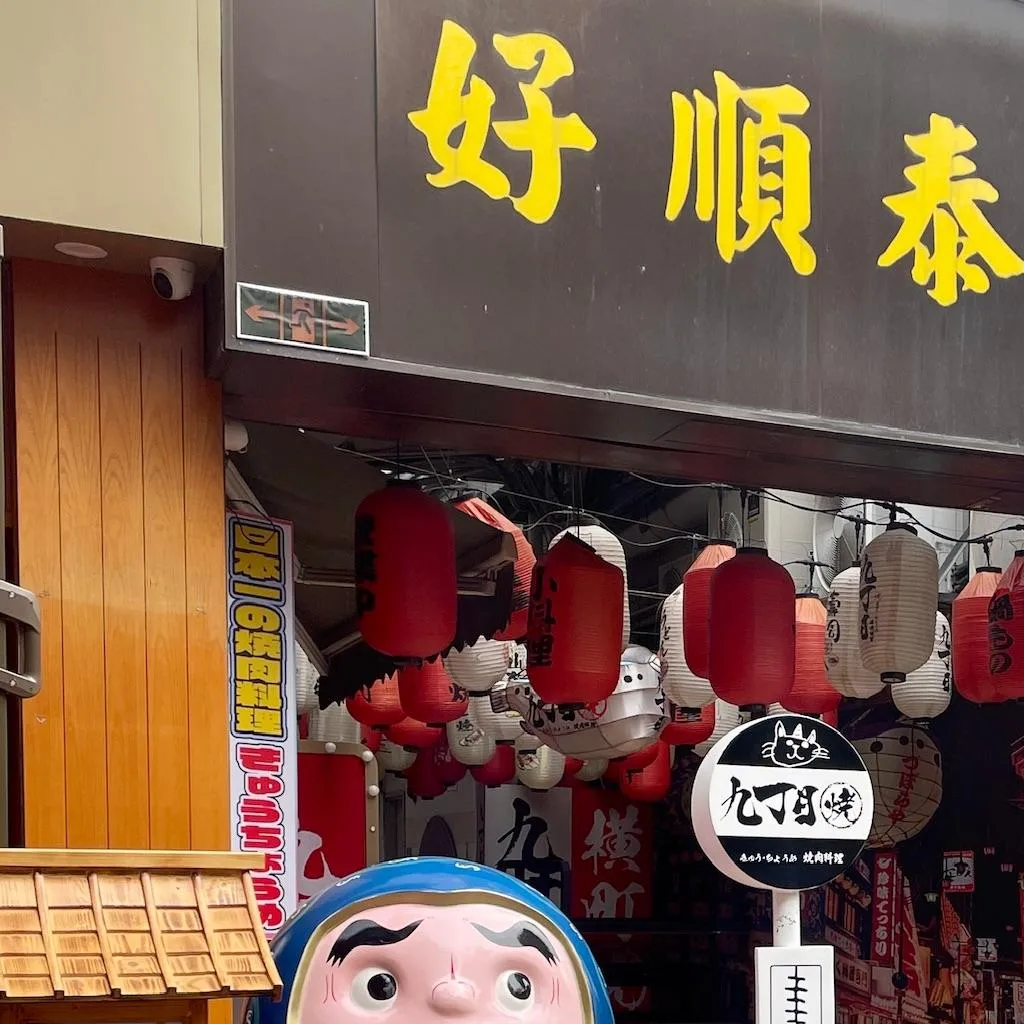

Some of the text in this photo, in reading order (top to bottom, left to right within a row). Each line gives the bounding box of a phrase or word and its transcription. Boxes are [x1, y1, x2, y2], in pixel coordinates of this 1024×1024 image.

[234, 523, 283, 737] 日本一の焼肉料理
[720, 776, 819, 827] 九丁目
[802, 850, 845, 866] 焼肉料理
